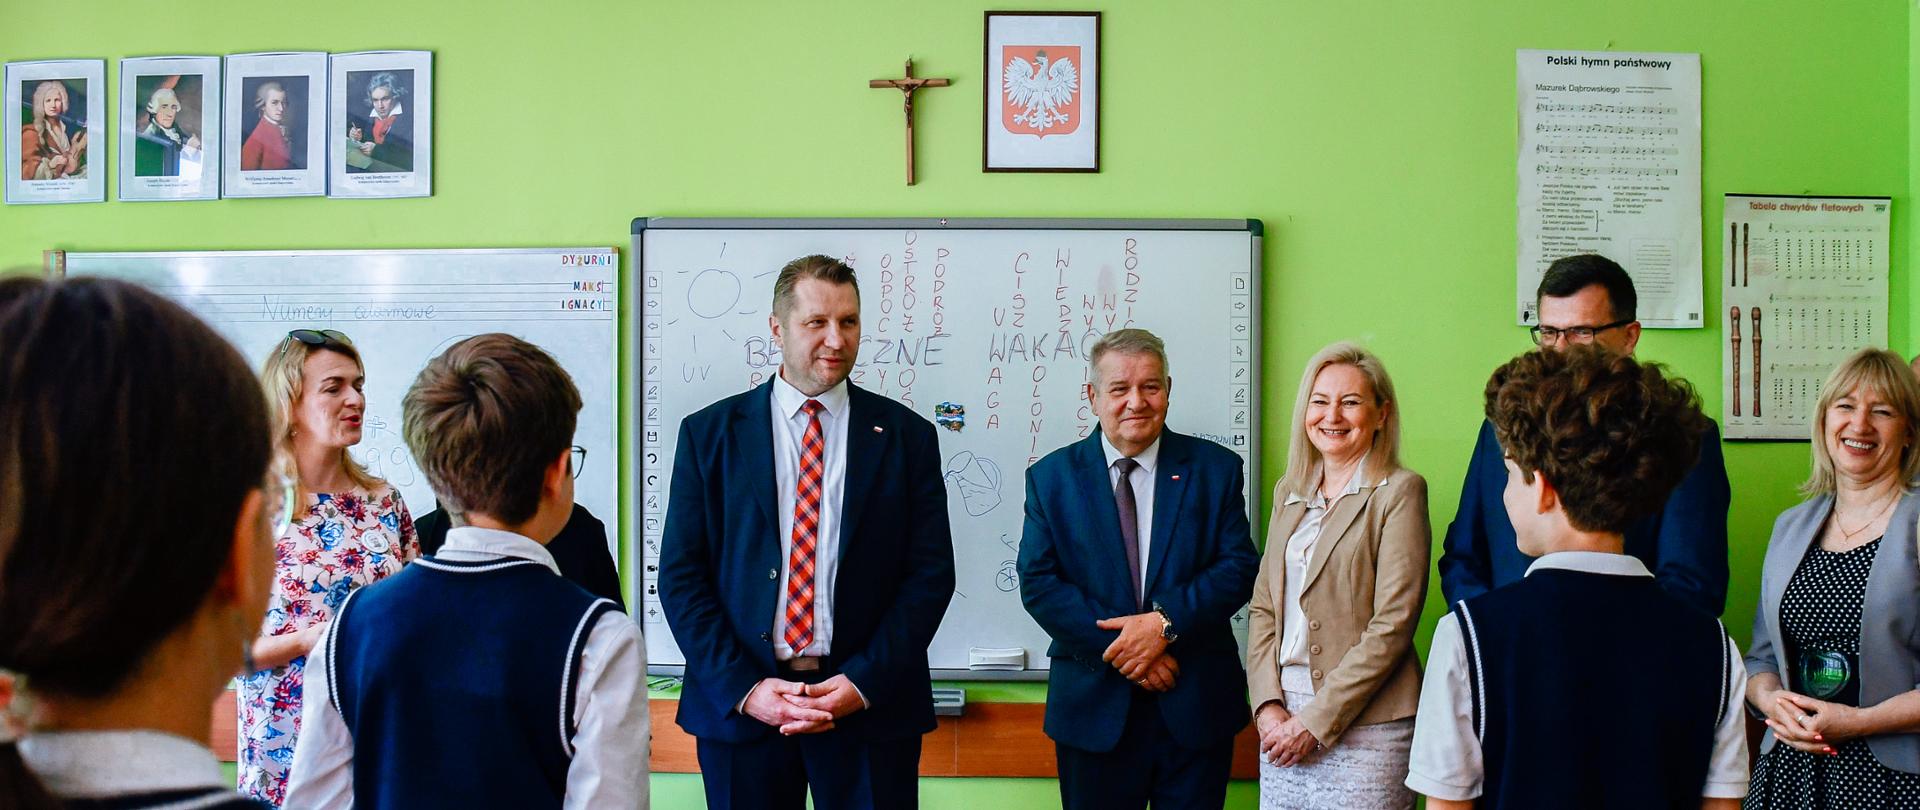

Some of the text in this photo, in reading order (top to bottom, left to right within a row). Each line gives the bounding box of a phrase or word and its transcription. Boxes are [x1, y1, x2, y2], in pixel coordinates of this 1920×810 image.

[1546, 55, 1672, 71] Polski hymn państwowy
[1535, 84, 1567, 92] Mazurek
[1568, 84, 1621, 94] Dąbrowskiego
[1749, 202, 1777, 211] Tabela
[1779, 202, 1818, 213] chwytów
[1821, 203, 1864, 213] fletowych
[573, 281, 602, 292] MAKS
[561, 299, 603, 310] IGNACY
[262, 295, 437, 328] Numery alarmowe
